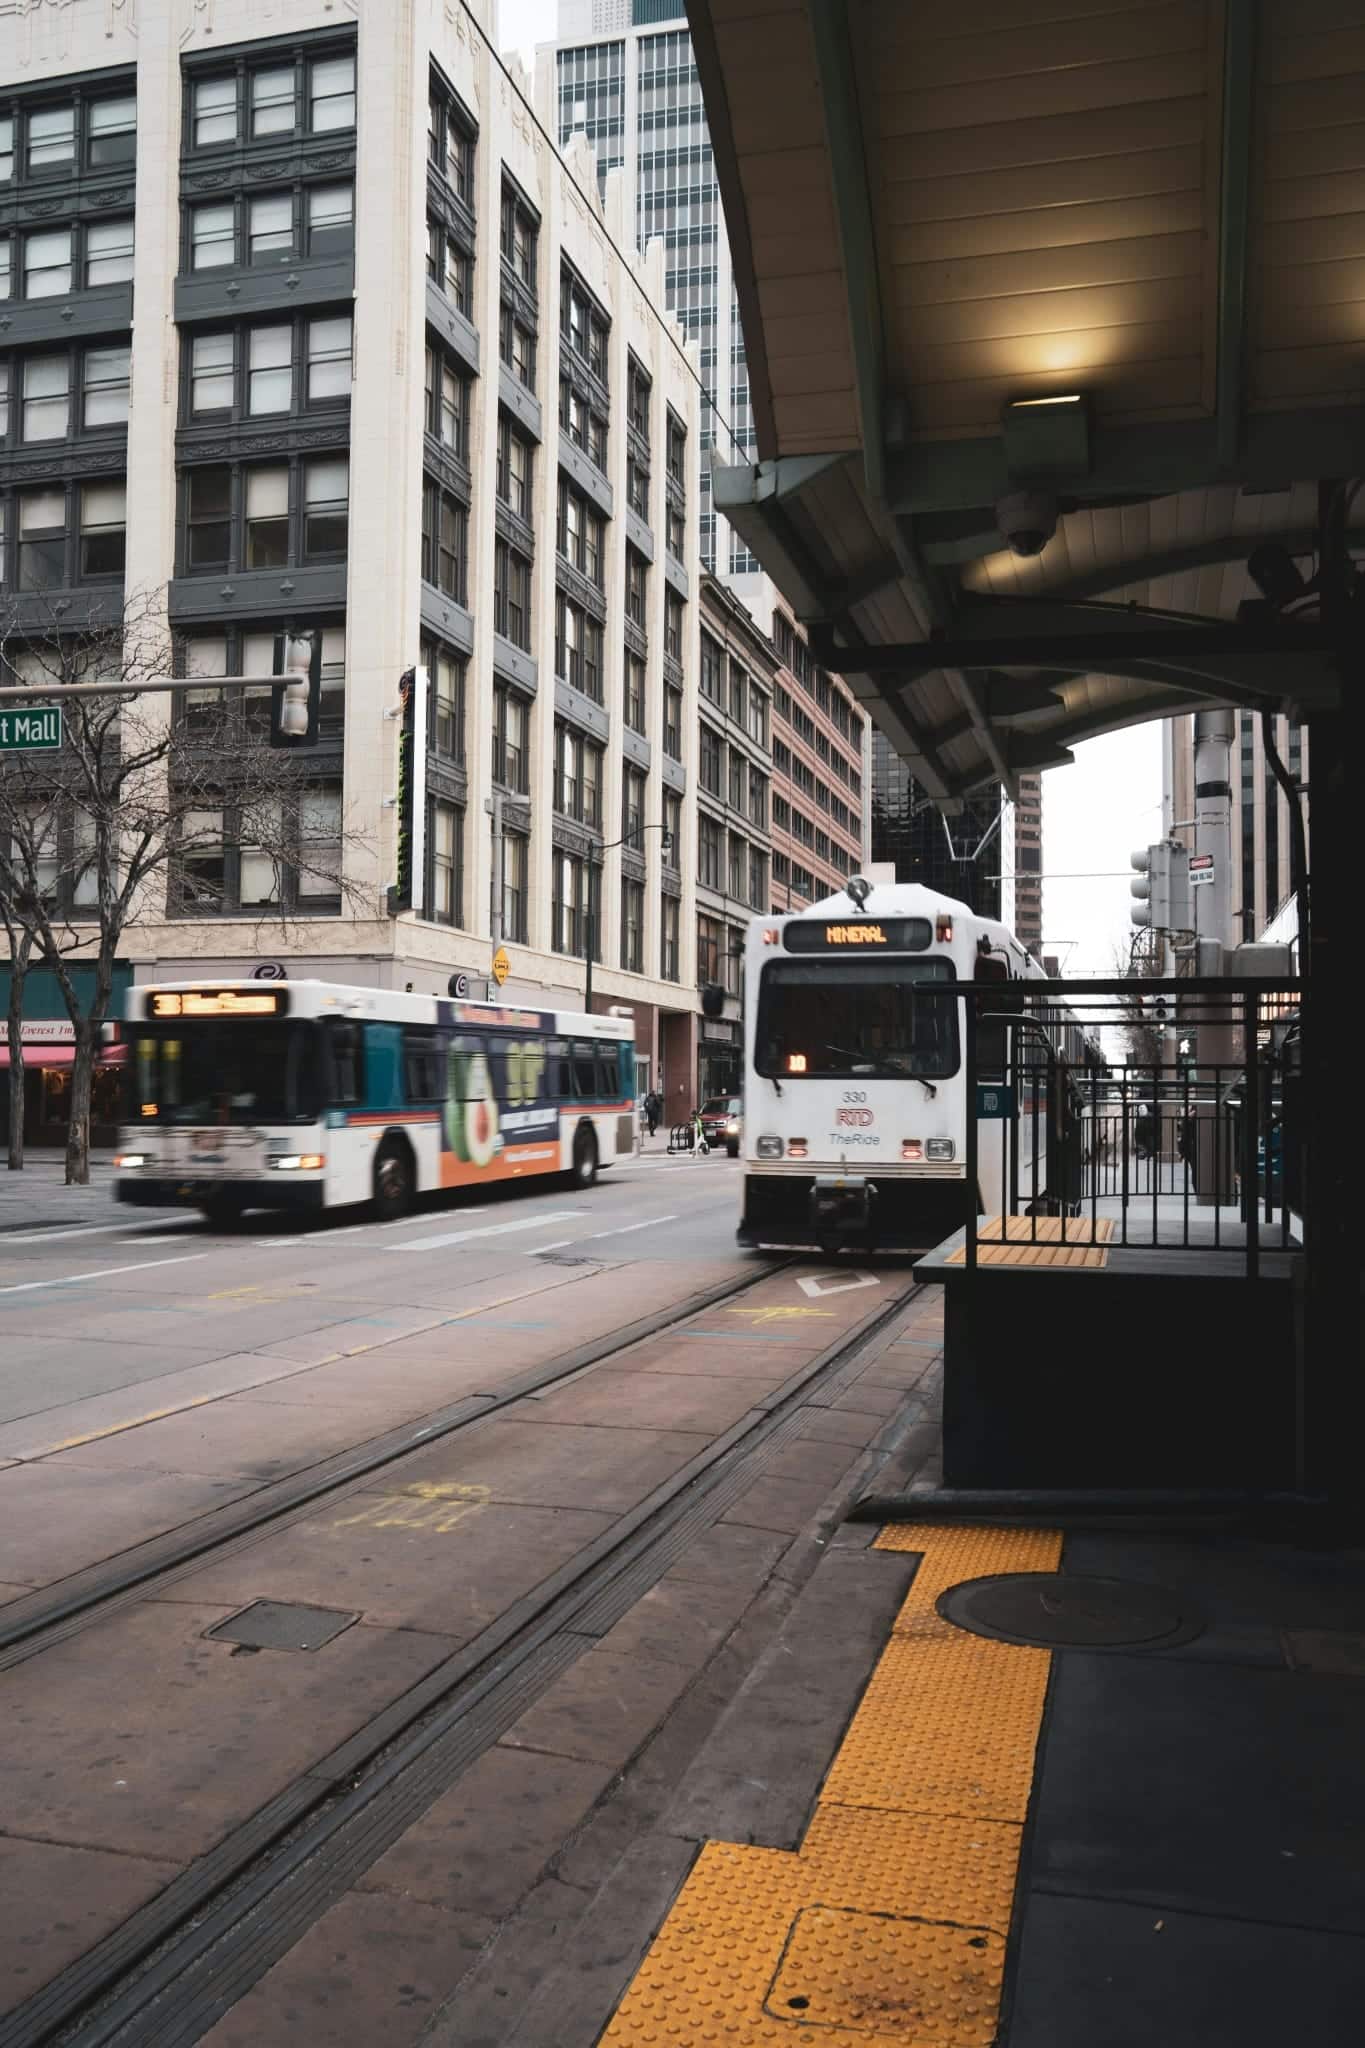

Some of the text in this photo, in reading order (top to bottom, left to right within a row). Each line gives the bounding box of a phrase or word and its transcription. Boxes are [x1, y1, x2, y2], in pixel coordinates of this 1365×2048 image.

[15, 713, 57, 742] Mall
[826, 926, 887, 942] MINERAL
[21, 1025, 55, 1035] Everest
[842, 1091, 867, 1103] 330
[836, 1108, 873, 1127] RTD
[828, 1133, 881, 1145] TheRide
